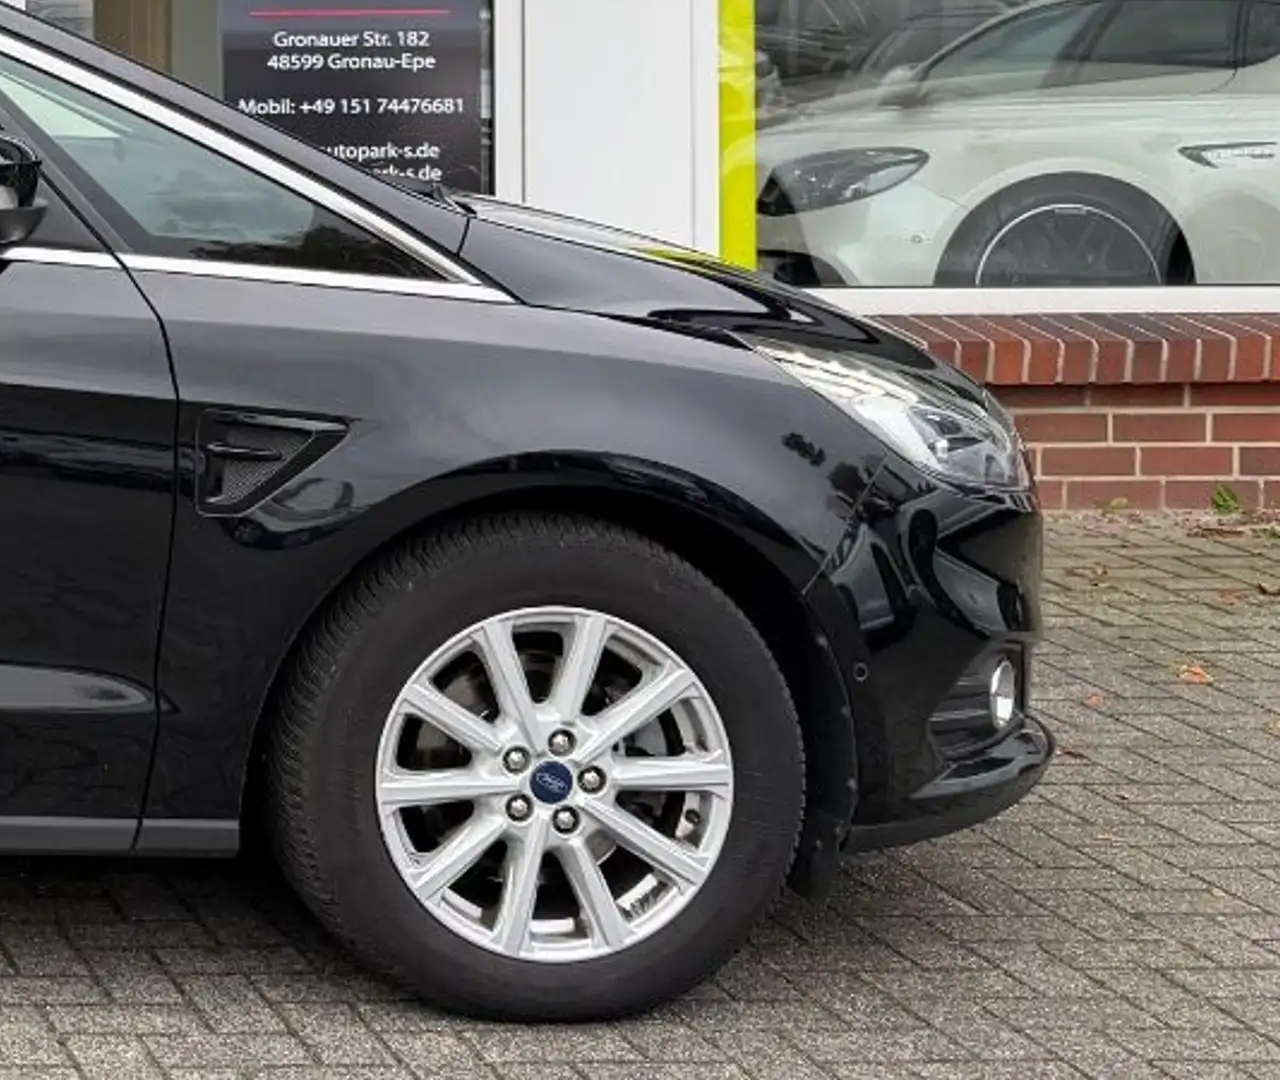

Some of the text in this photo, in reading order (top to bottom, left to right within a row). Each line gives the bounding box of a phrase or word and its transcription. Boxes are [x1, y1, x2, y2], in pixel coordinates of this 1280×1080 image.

[272, 31, 430, 47] Gronauer Str. 182
[266, 53, 436, 73] 48599 Gronau-Epe
[238, 98, 464, 115] Mobil: +49 151 74476681
